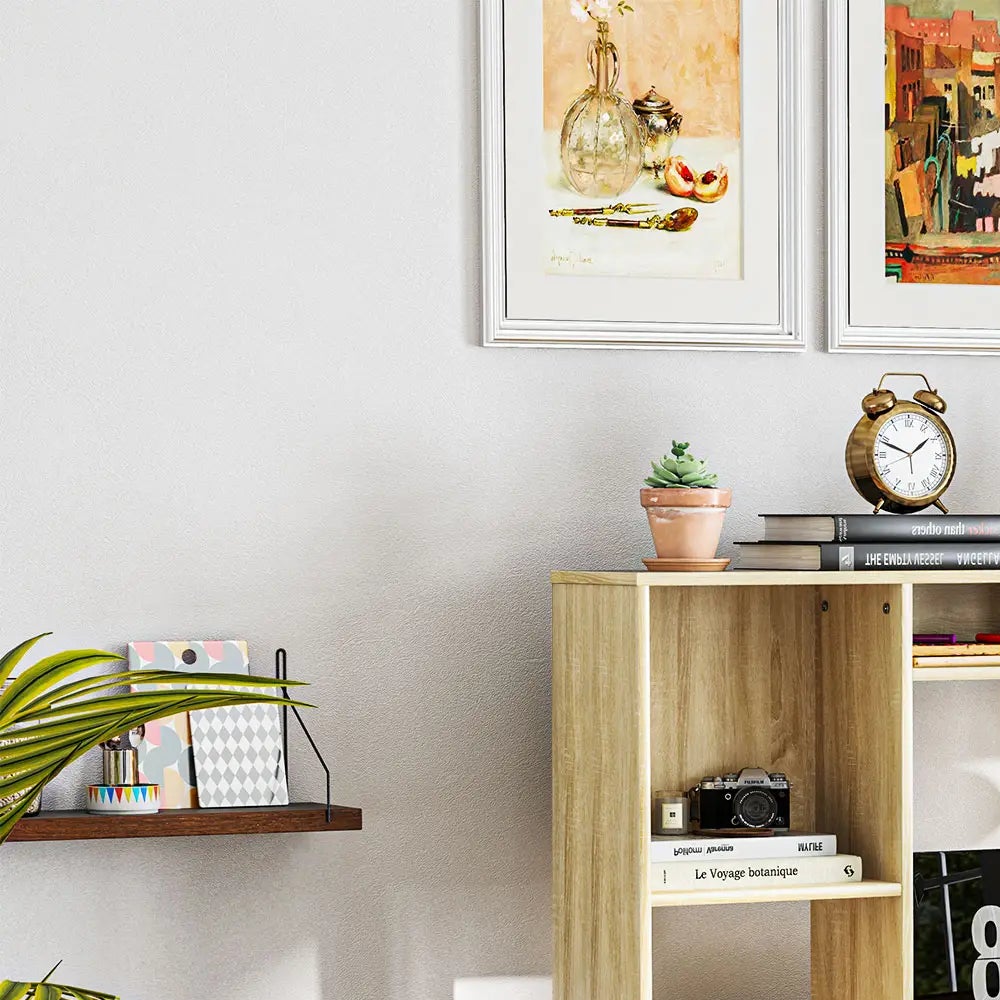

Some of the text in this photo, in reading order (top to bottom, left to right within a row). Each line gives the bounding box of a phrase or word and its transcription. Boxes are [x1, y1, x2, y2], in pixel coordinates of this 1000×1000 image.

[695, 865, 798, 881] Le Voyage botanique
